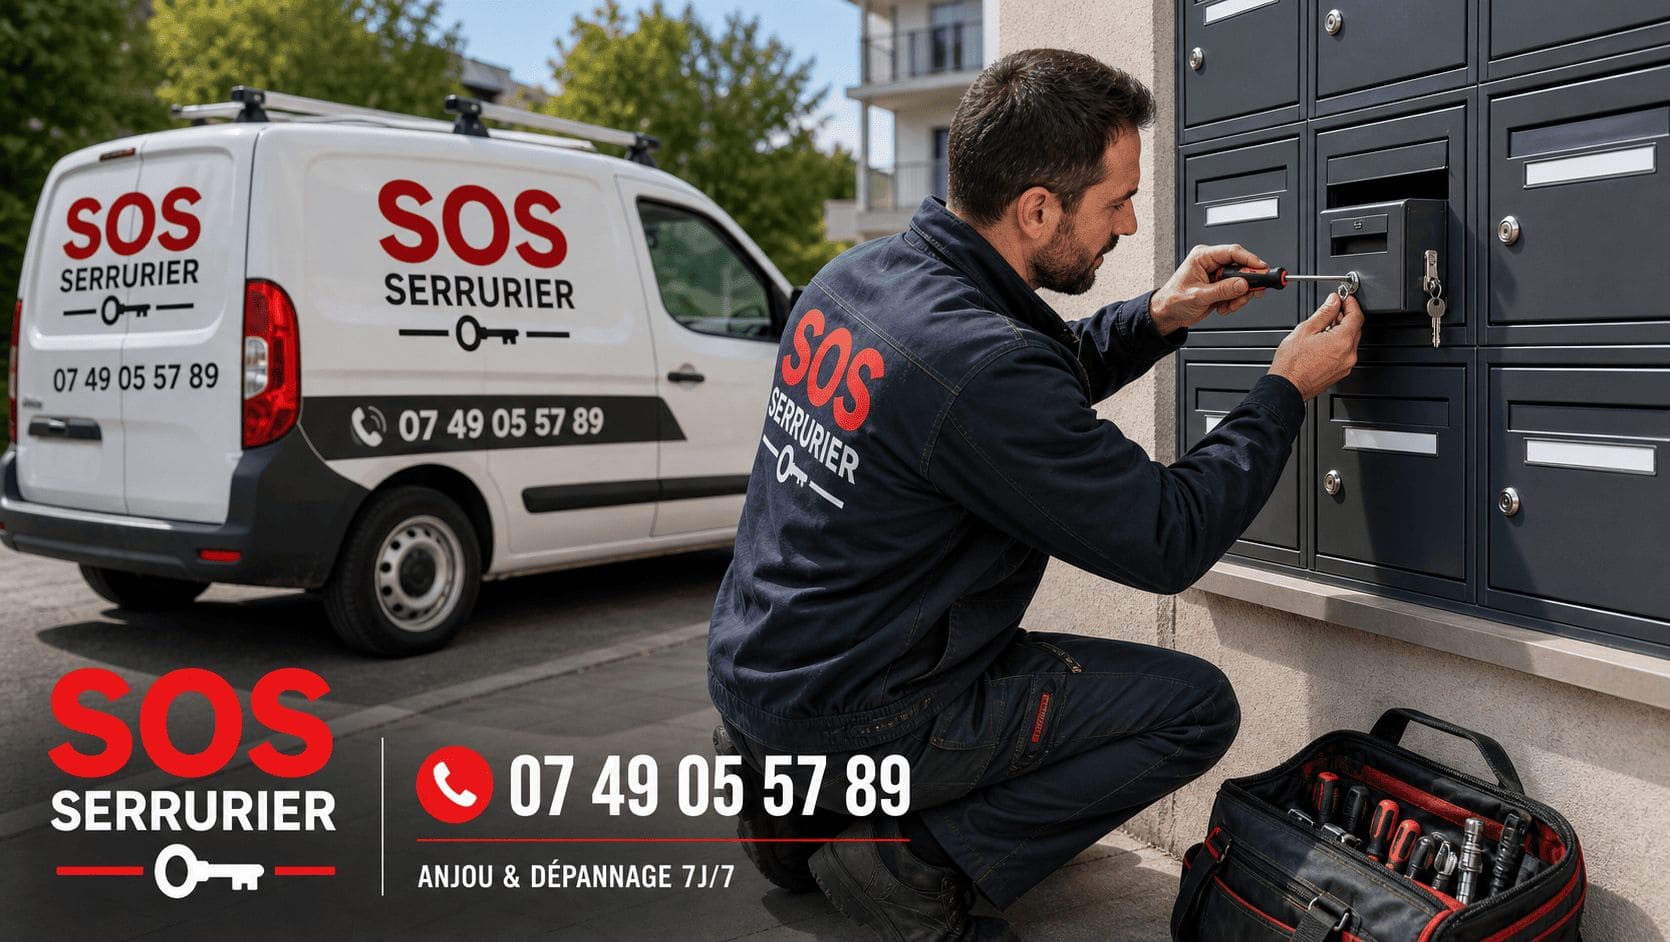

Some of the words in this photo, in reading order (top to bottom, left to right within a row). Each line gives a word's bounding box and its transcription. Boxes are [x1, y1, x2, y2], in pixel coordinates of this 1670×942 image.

[63, 186, 202, 260] SOS
[378, 179, 568, 269] SOS
[60, 259, 199, 292] SERRURIER
[384, 273, 575, 309] SERRURIER
[53, 368, 78, 392] 07
[85, 366, 110, 391] 49
[118, 365, 145, 390] 05
[153, 364, 181, 389] 57
[189, 362, 219, 388] 89
[781, 308, 885, 431] SOS
[399, 409, 438, 442] 07
[447, 408, 484, 439] 49
[492, 407, 527, 438] 05
[534, 407, 566, 437] 57
[572, 406, 605, 436] 89
[768, 386, 859, 485] SERRURIER
